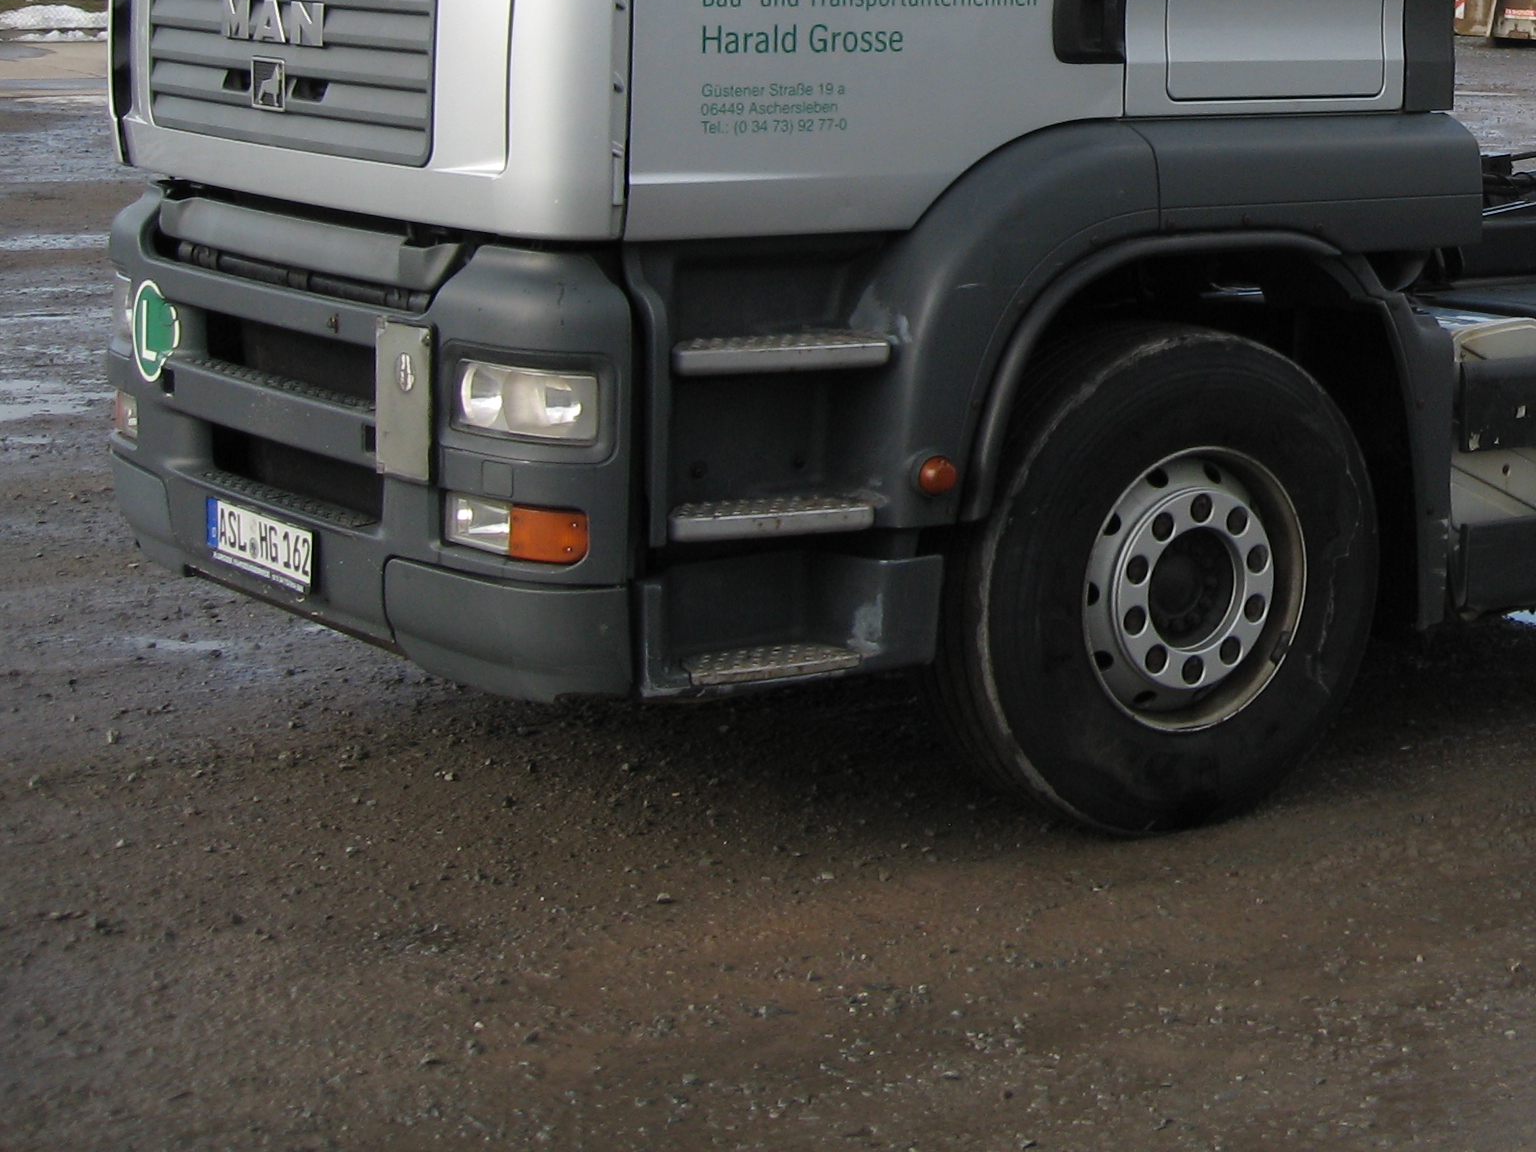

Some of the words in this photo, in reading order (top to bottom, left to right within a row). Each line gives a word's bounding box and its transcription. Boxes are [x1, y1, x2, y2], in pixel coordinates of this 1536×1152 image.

[702, 24, 797, 54] Harald
[809, 24, 904, 53] Grosse
[701, 83, 765, 97] Güstener
[769, 82, 813, 96] Straße
[819, 82, 834, 95] 19
[837, 86, 845, 95] a
[701, 102, 744, 116] 06449
[749, 101, 838, 115] Aschersleben
[701, 120, 729, 134] Tel.:
[734, 120, 747, 136] (0
[752, 120, 767, 133] 34
[772, 119, 794, 135] 73)
[798, 119, 814, 132] 92
[819, 118, 847, 131] 77-0
[142, 299, 158, 362] L
[219, 507, 247, 553] ASL
[258, 520, 279, 564] HG
[283, 531, 311, 577] 162
